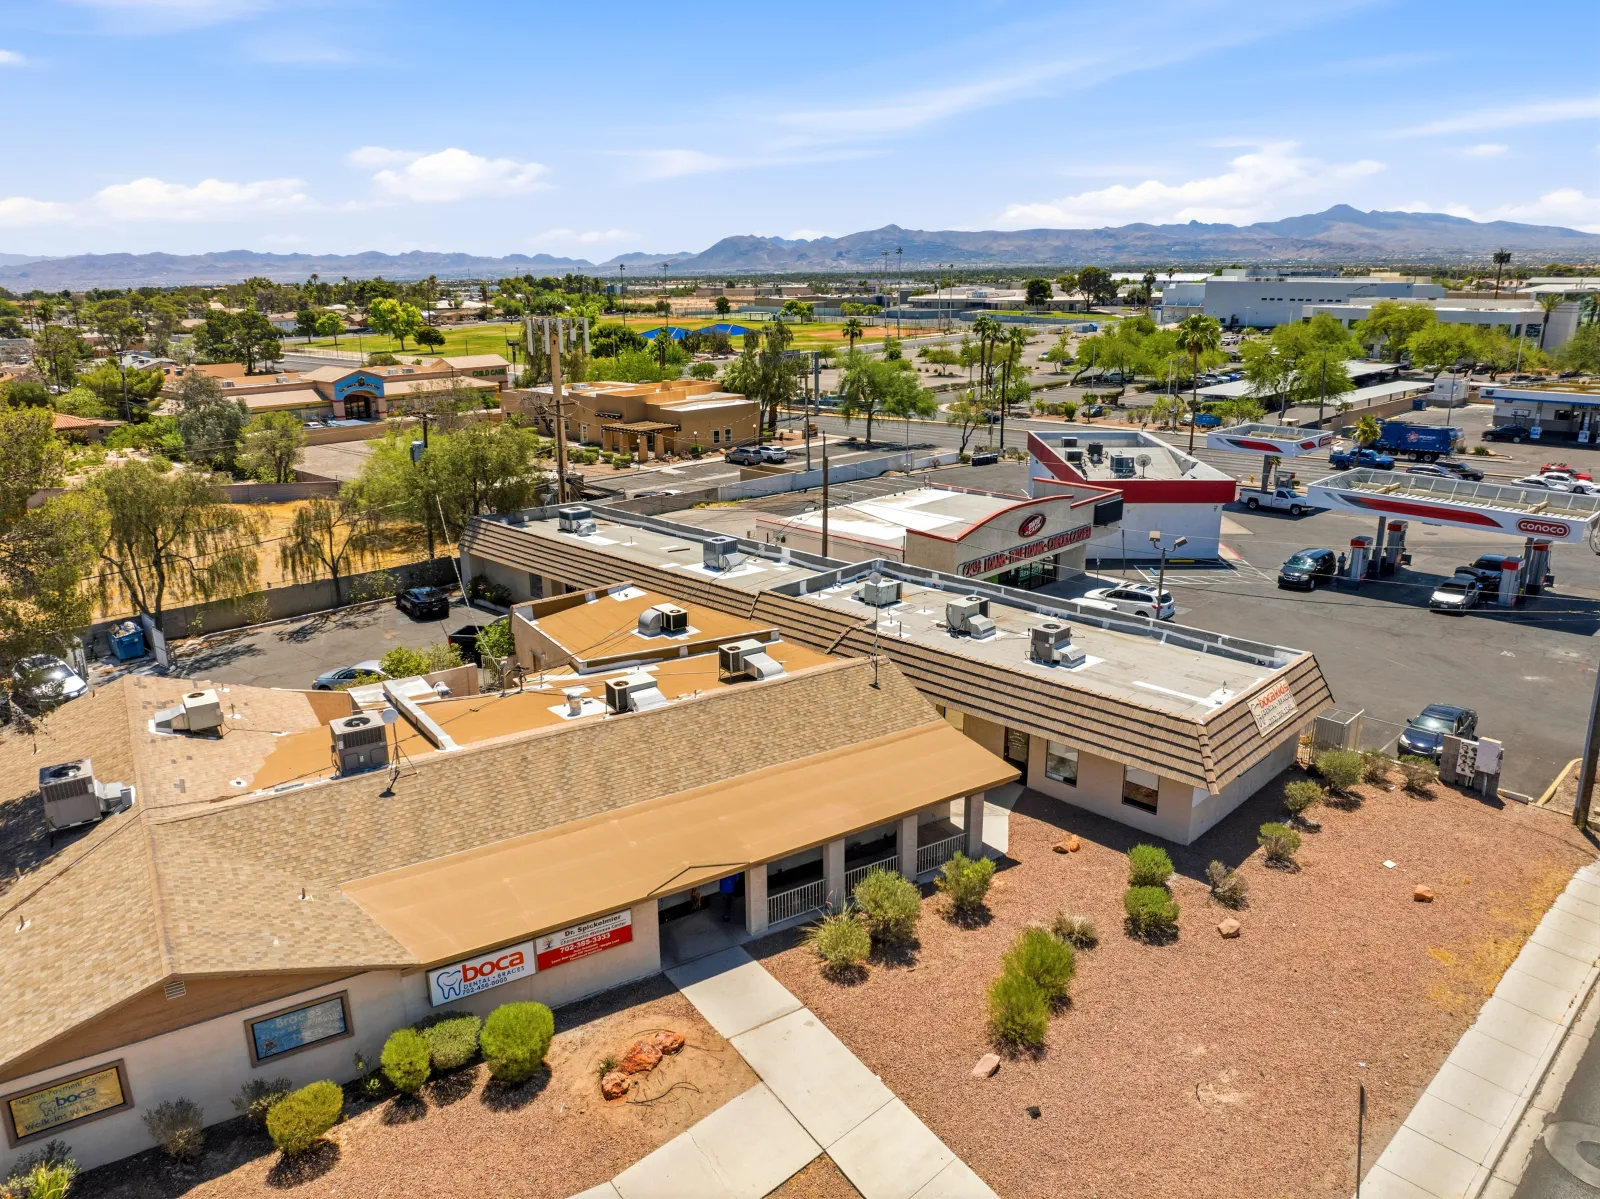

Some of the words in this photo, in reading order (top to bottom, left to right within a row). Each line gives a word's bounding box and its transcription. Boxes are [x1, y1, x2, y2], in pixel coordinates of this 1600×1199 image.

[1520, 522, 1565, 534] conoco
[461, 951, 525, 983] boca
[463, 978, 491, 990] DENTAL
[497, 965, 525, 979] BRACES
[56, 1087, 97, 1107] boca
